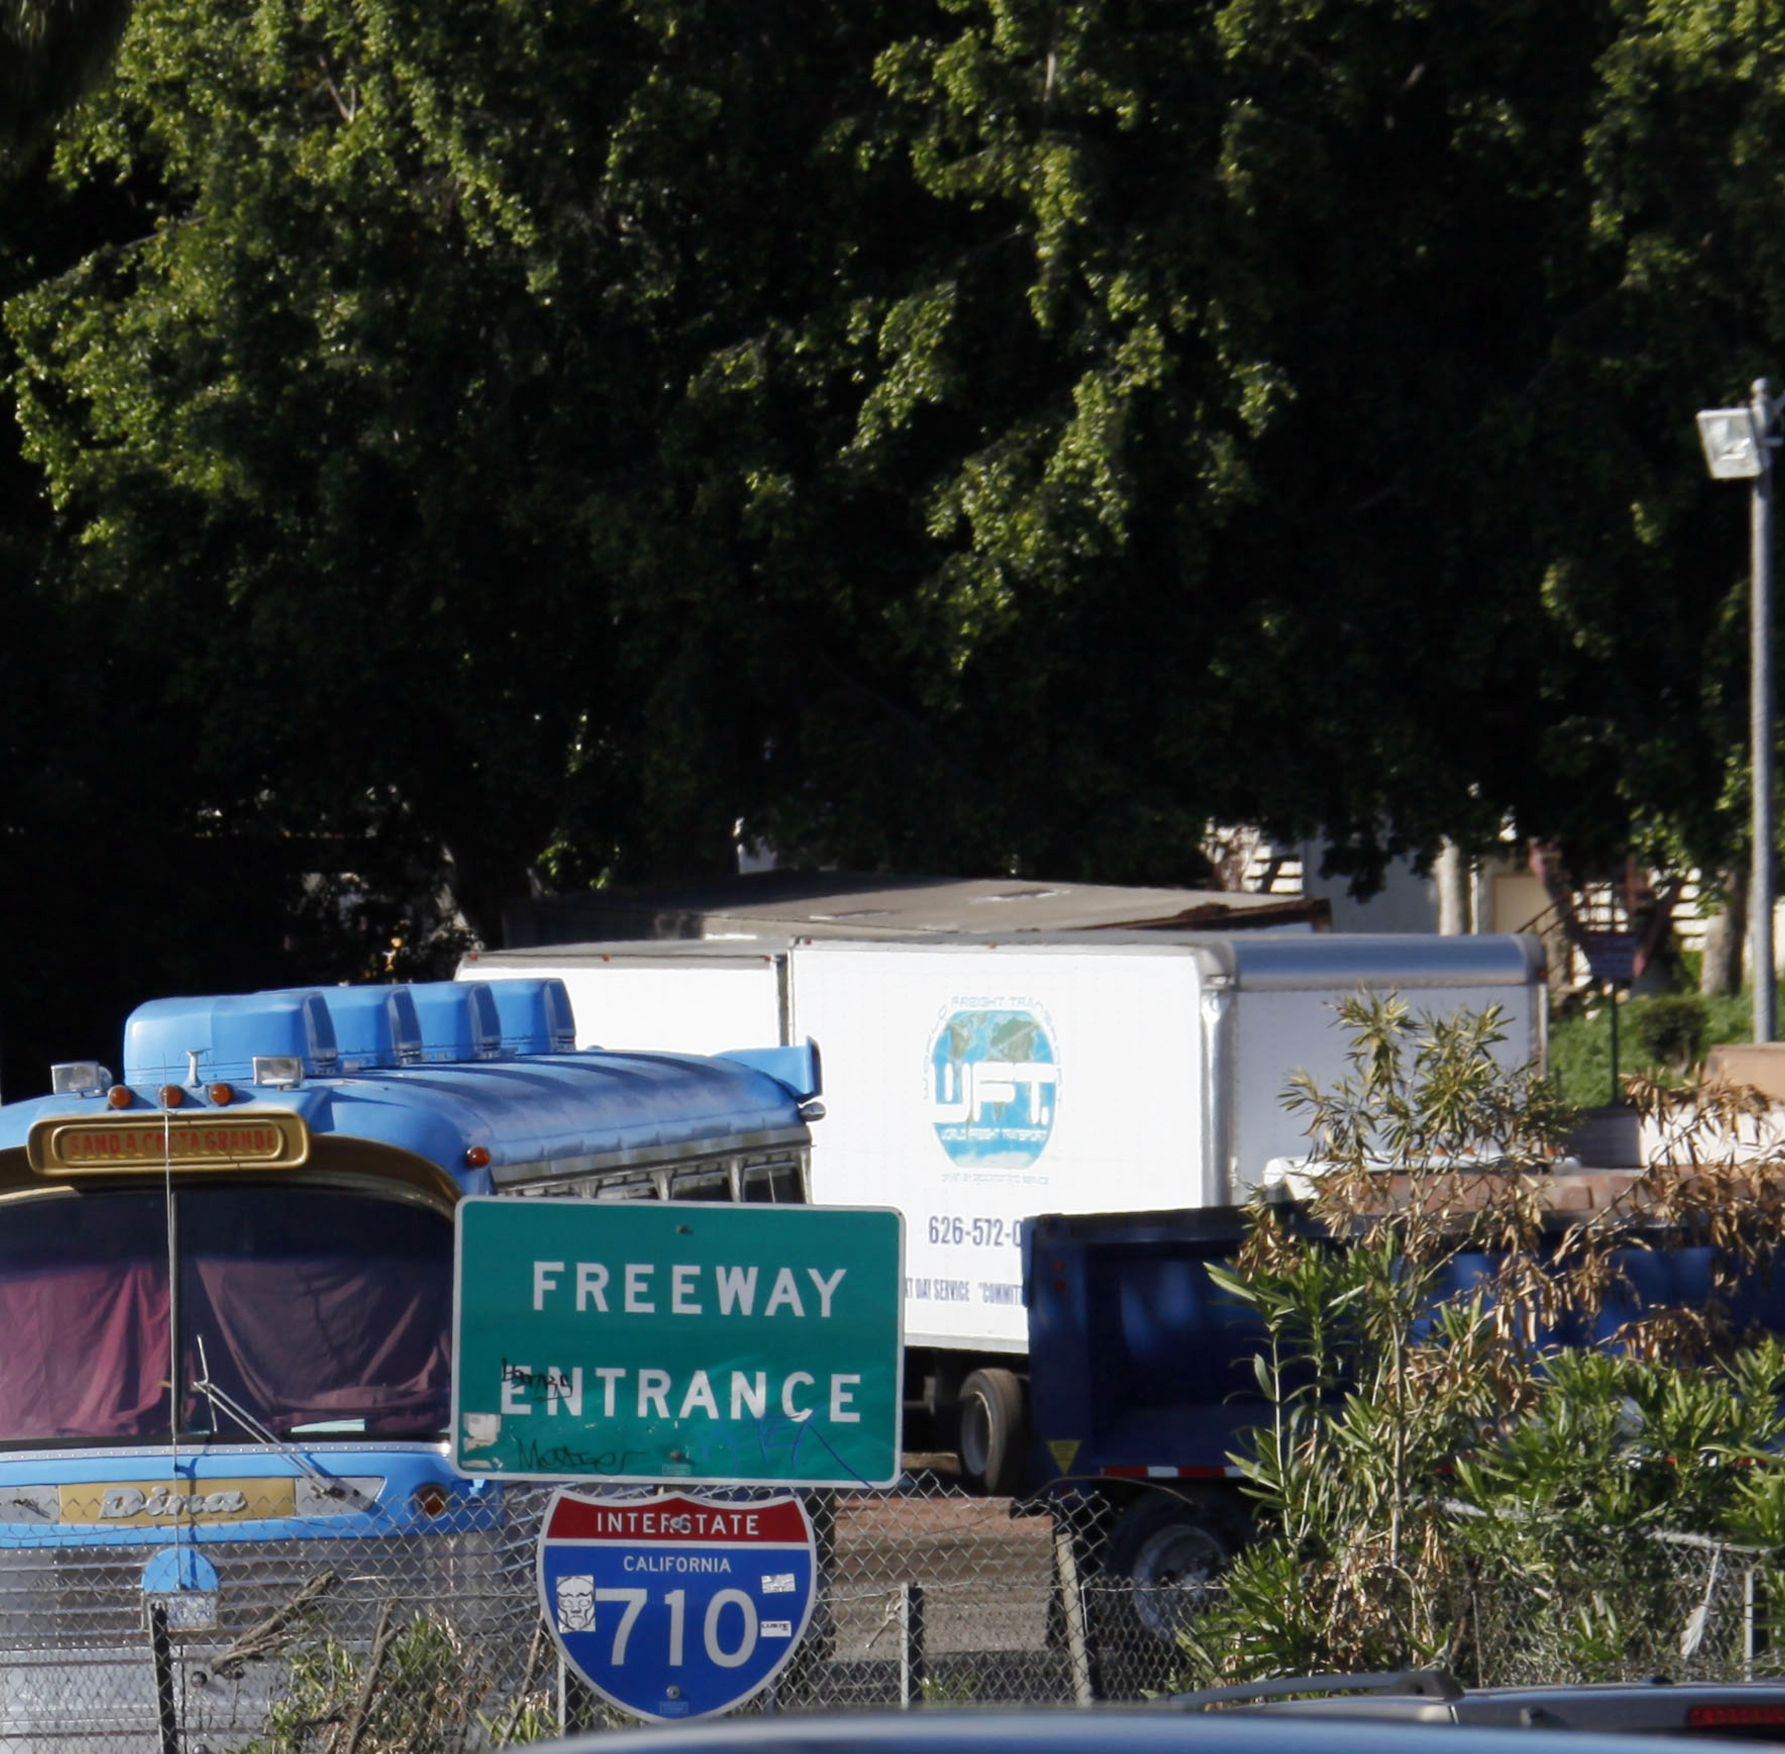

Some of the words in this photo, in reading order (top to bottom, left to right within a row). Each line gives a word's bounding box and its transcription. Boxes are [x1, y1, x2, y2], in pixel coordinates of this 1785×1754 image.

[206, 1129, 275, 1149] GRANDE
[533, 1260, 848, 1317] FREEWAY
[916, 1278, 931, 1299] DAY
[934, 1279, 969, 1302] SERVICE
[501, 1366, 861, 1423] ENTRANCE
[99, 1486, 247, 1519] Dina
[597, 1512, 760, 1535] INTERSTATE
[623, 1555, 732, 1573] CALIFORNIA
[595, 1588, 759, 1668] 710
